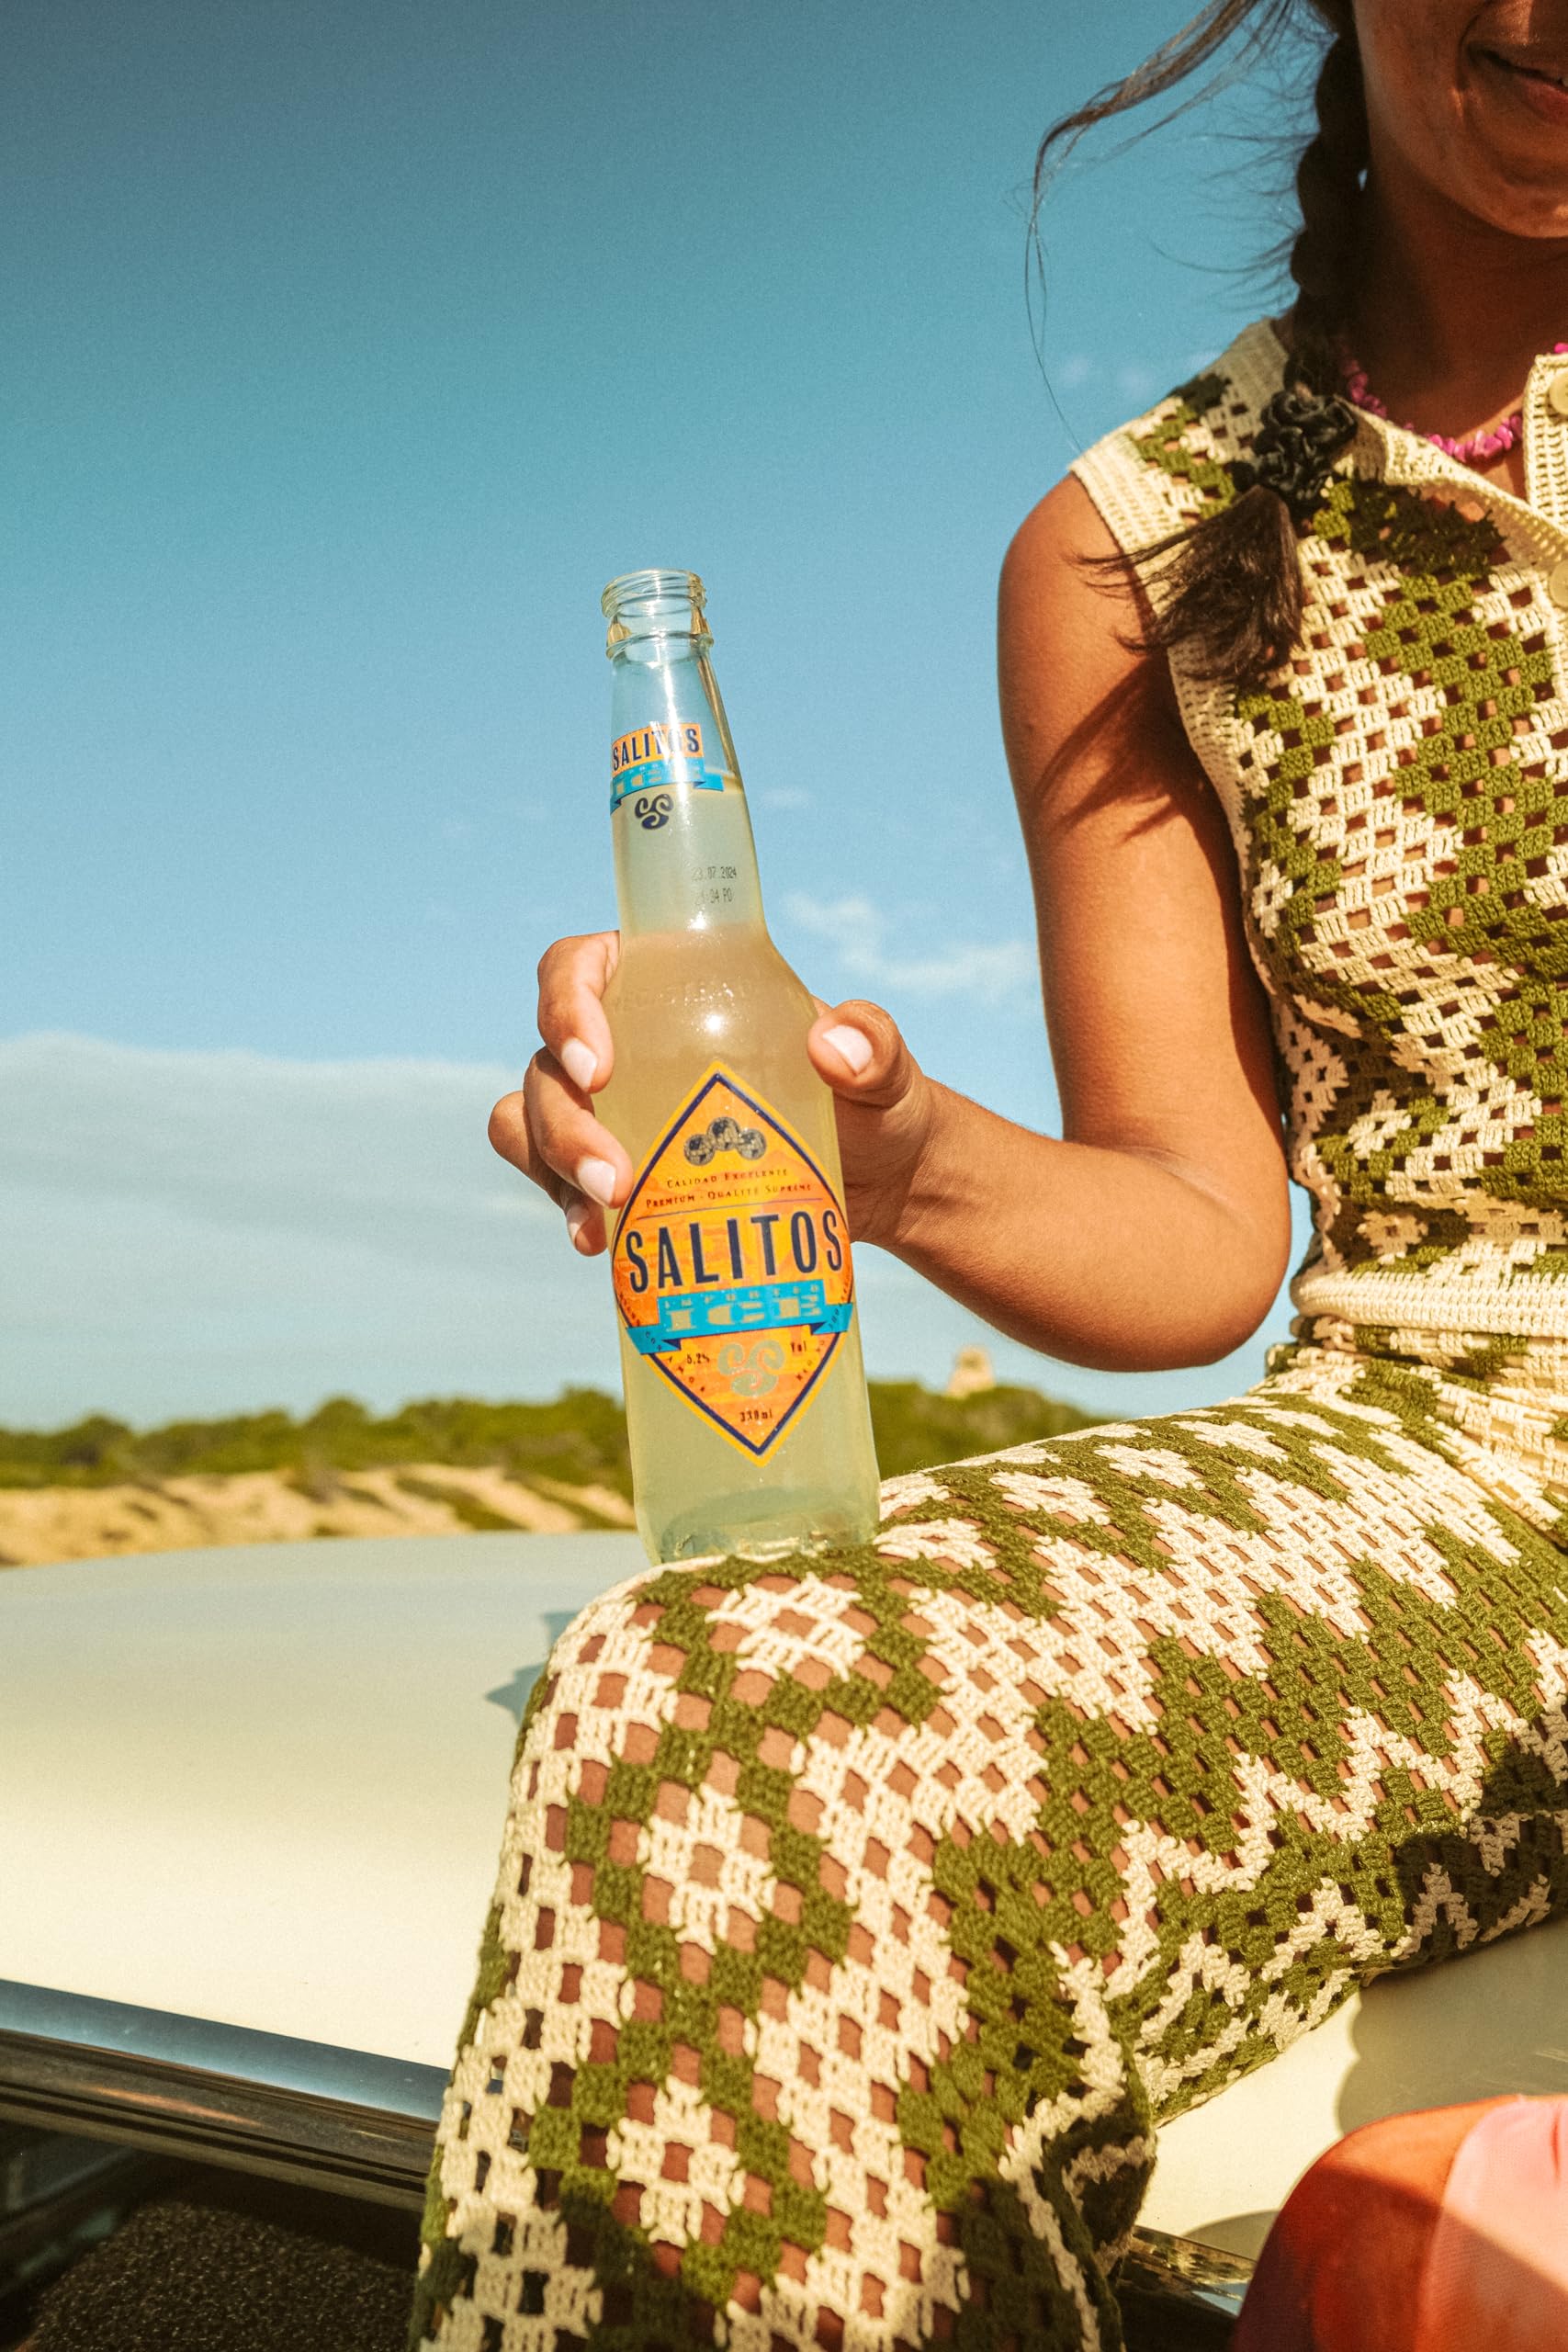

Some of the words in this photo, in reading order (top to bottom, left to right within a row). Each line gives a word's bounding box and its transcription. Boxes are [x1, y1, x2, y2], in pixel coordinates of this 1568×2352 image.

[666, 1174, 718, 1190] CALIDAD
[646, 1194, 695, 1209] PREMIUM
[626, 1208, 843, 1295] SALITOS
[664, 1294, 823, 1332] ICE
